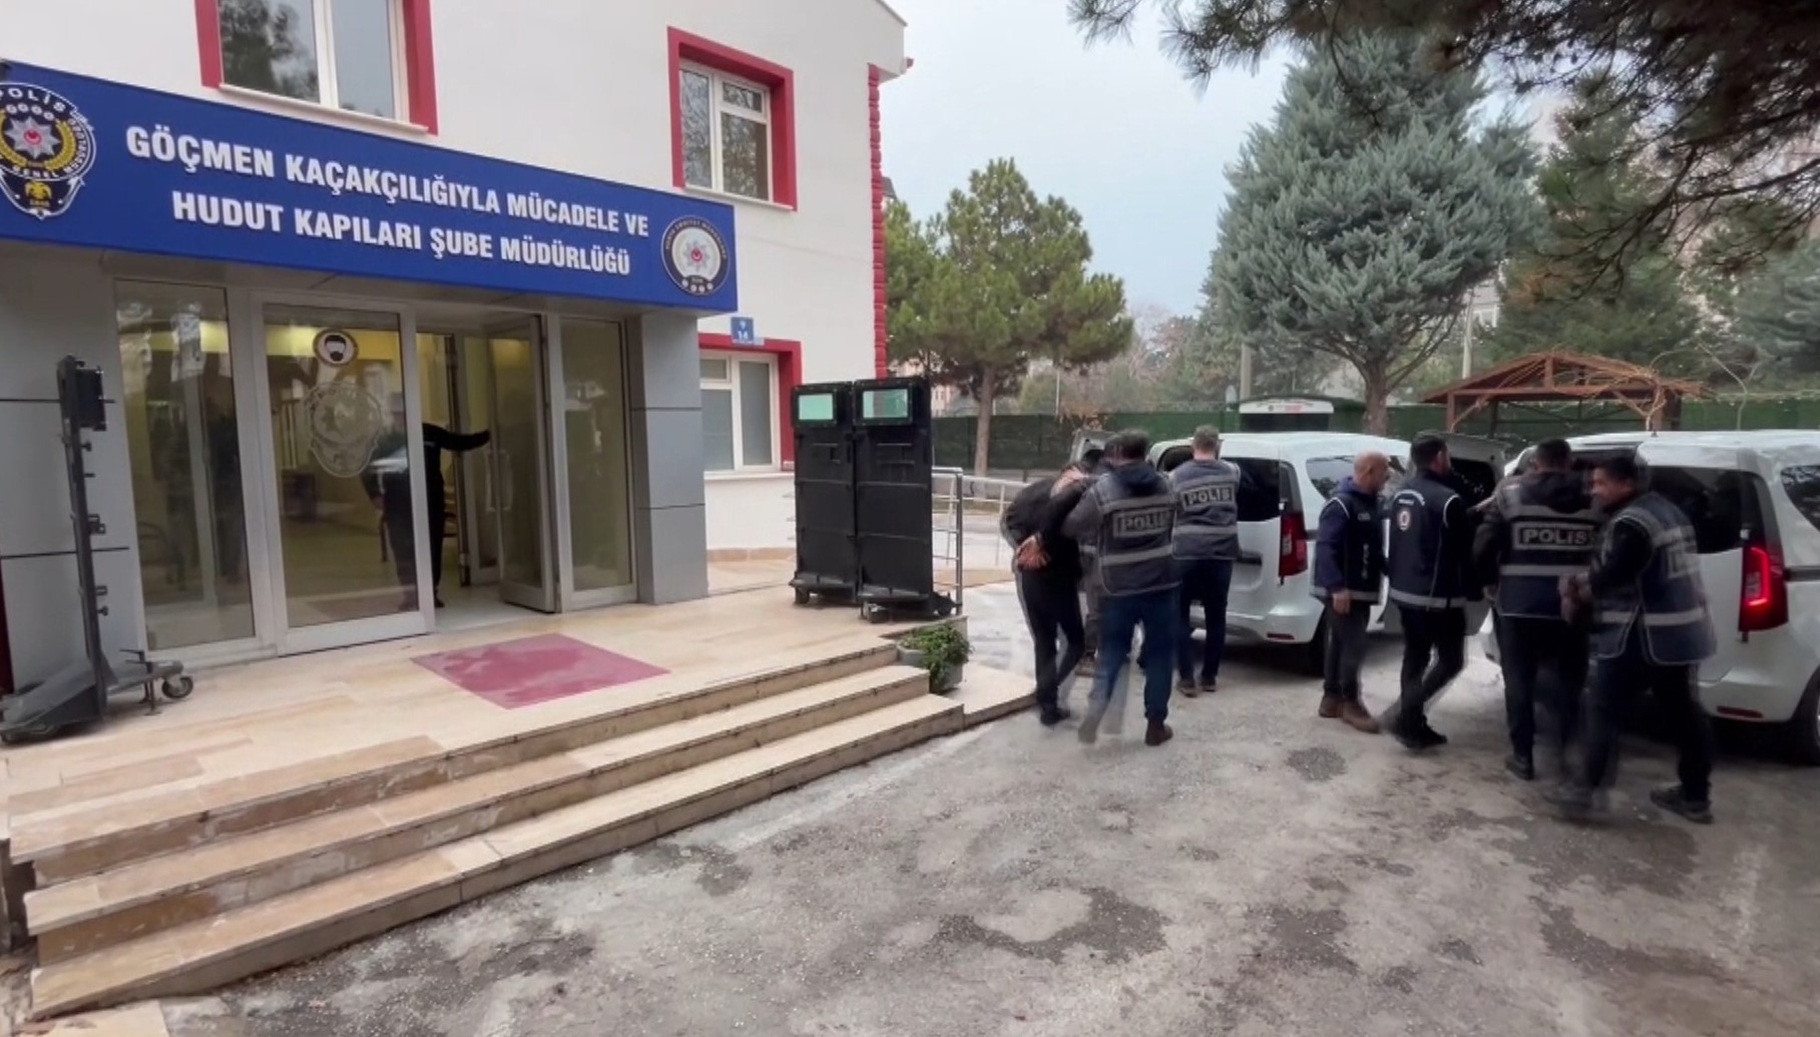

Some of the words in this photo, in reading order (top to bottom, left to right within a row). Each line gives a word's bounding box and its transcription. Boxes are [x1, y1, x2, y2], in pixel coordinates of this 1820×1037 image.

[127, 125, 274, 177] GÖÇMEN
[286, 153, 500, 213] KAÇAKÇILIĞIYLA
[507, 192, 619, 232] MÜCADELE
[625, 212, 648, 237] VE
[173, 190, 283, 231] HUDUT
[295, 208, 421, 250] KAPILARI
[430, 228, 493, 259] ŞUBE
[501, 235, 630, 275] MÜDÜRLÜĞÜ
